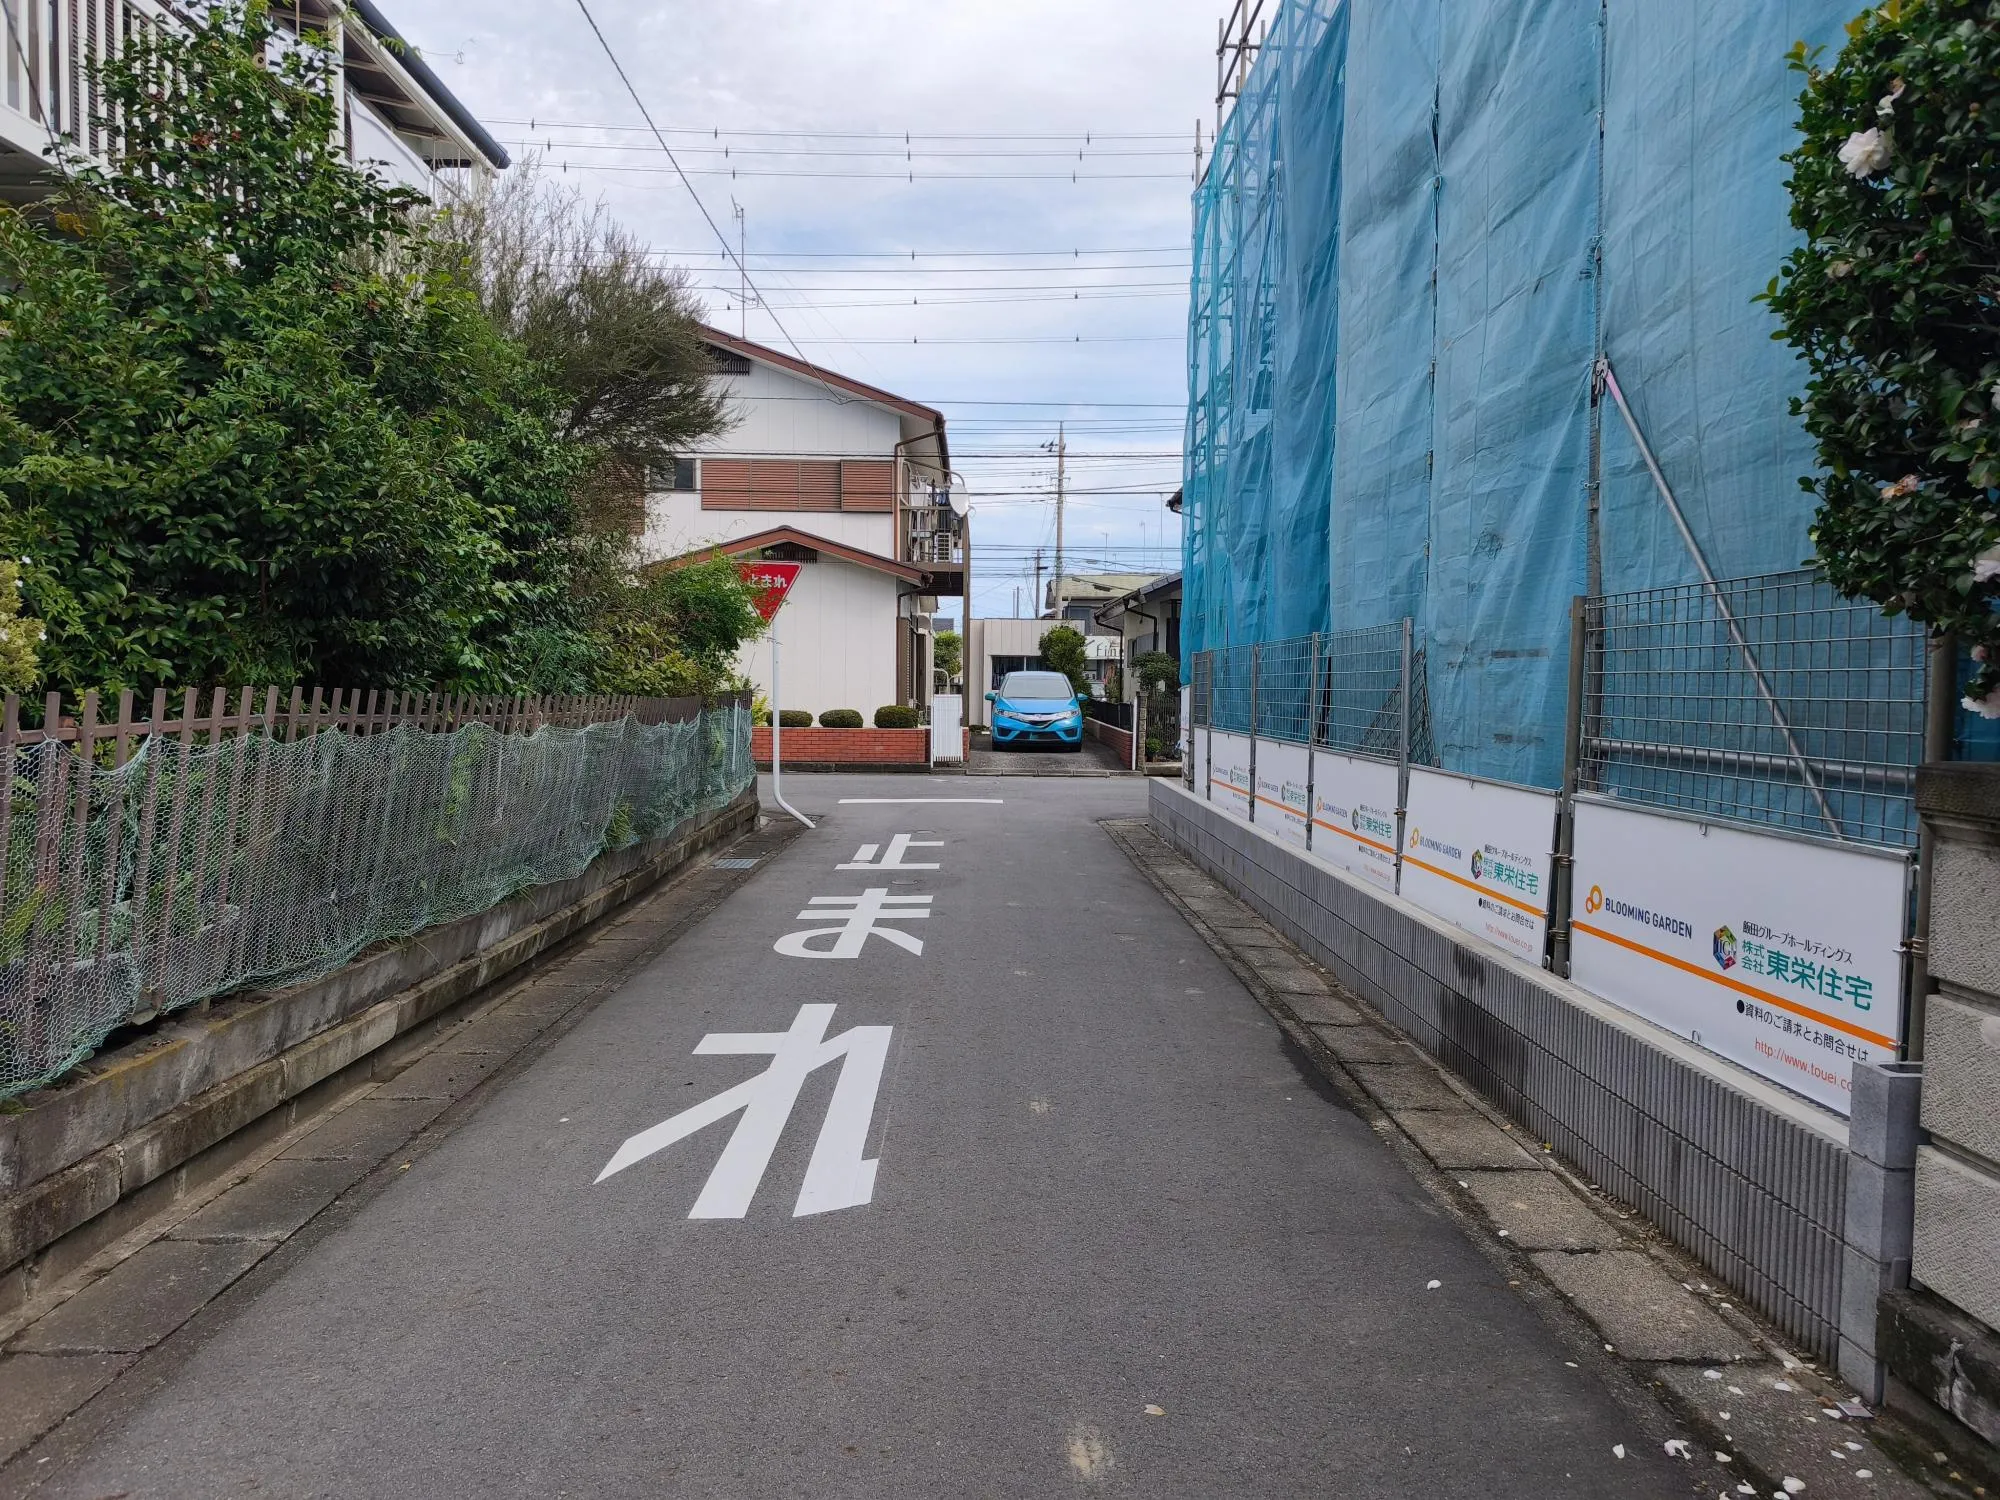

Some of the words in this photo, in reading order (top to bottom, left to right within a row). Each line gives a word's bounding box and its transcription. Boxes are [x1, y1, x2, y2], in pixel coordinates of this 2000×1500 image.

[1420, 836, 1442, 853] BLOOMING
[1442, 845, 1462, 860] GARDEN
[1493, 861, 1539, 895] 東栄住宅
[1605, 897, 1650, 925] BLOOMING
[1652, 913, 1692, 940] GARDEN
[1743, 920, 1853, 965] 飯田グループホールディングス
[1766, 949, 1873, 1011] 東栄住宅
